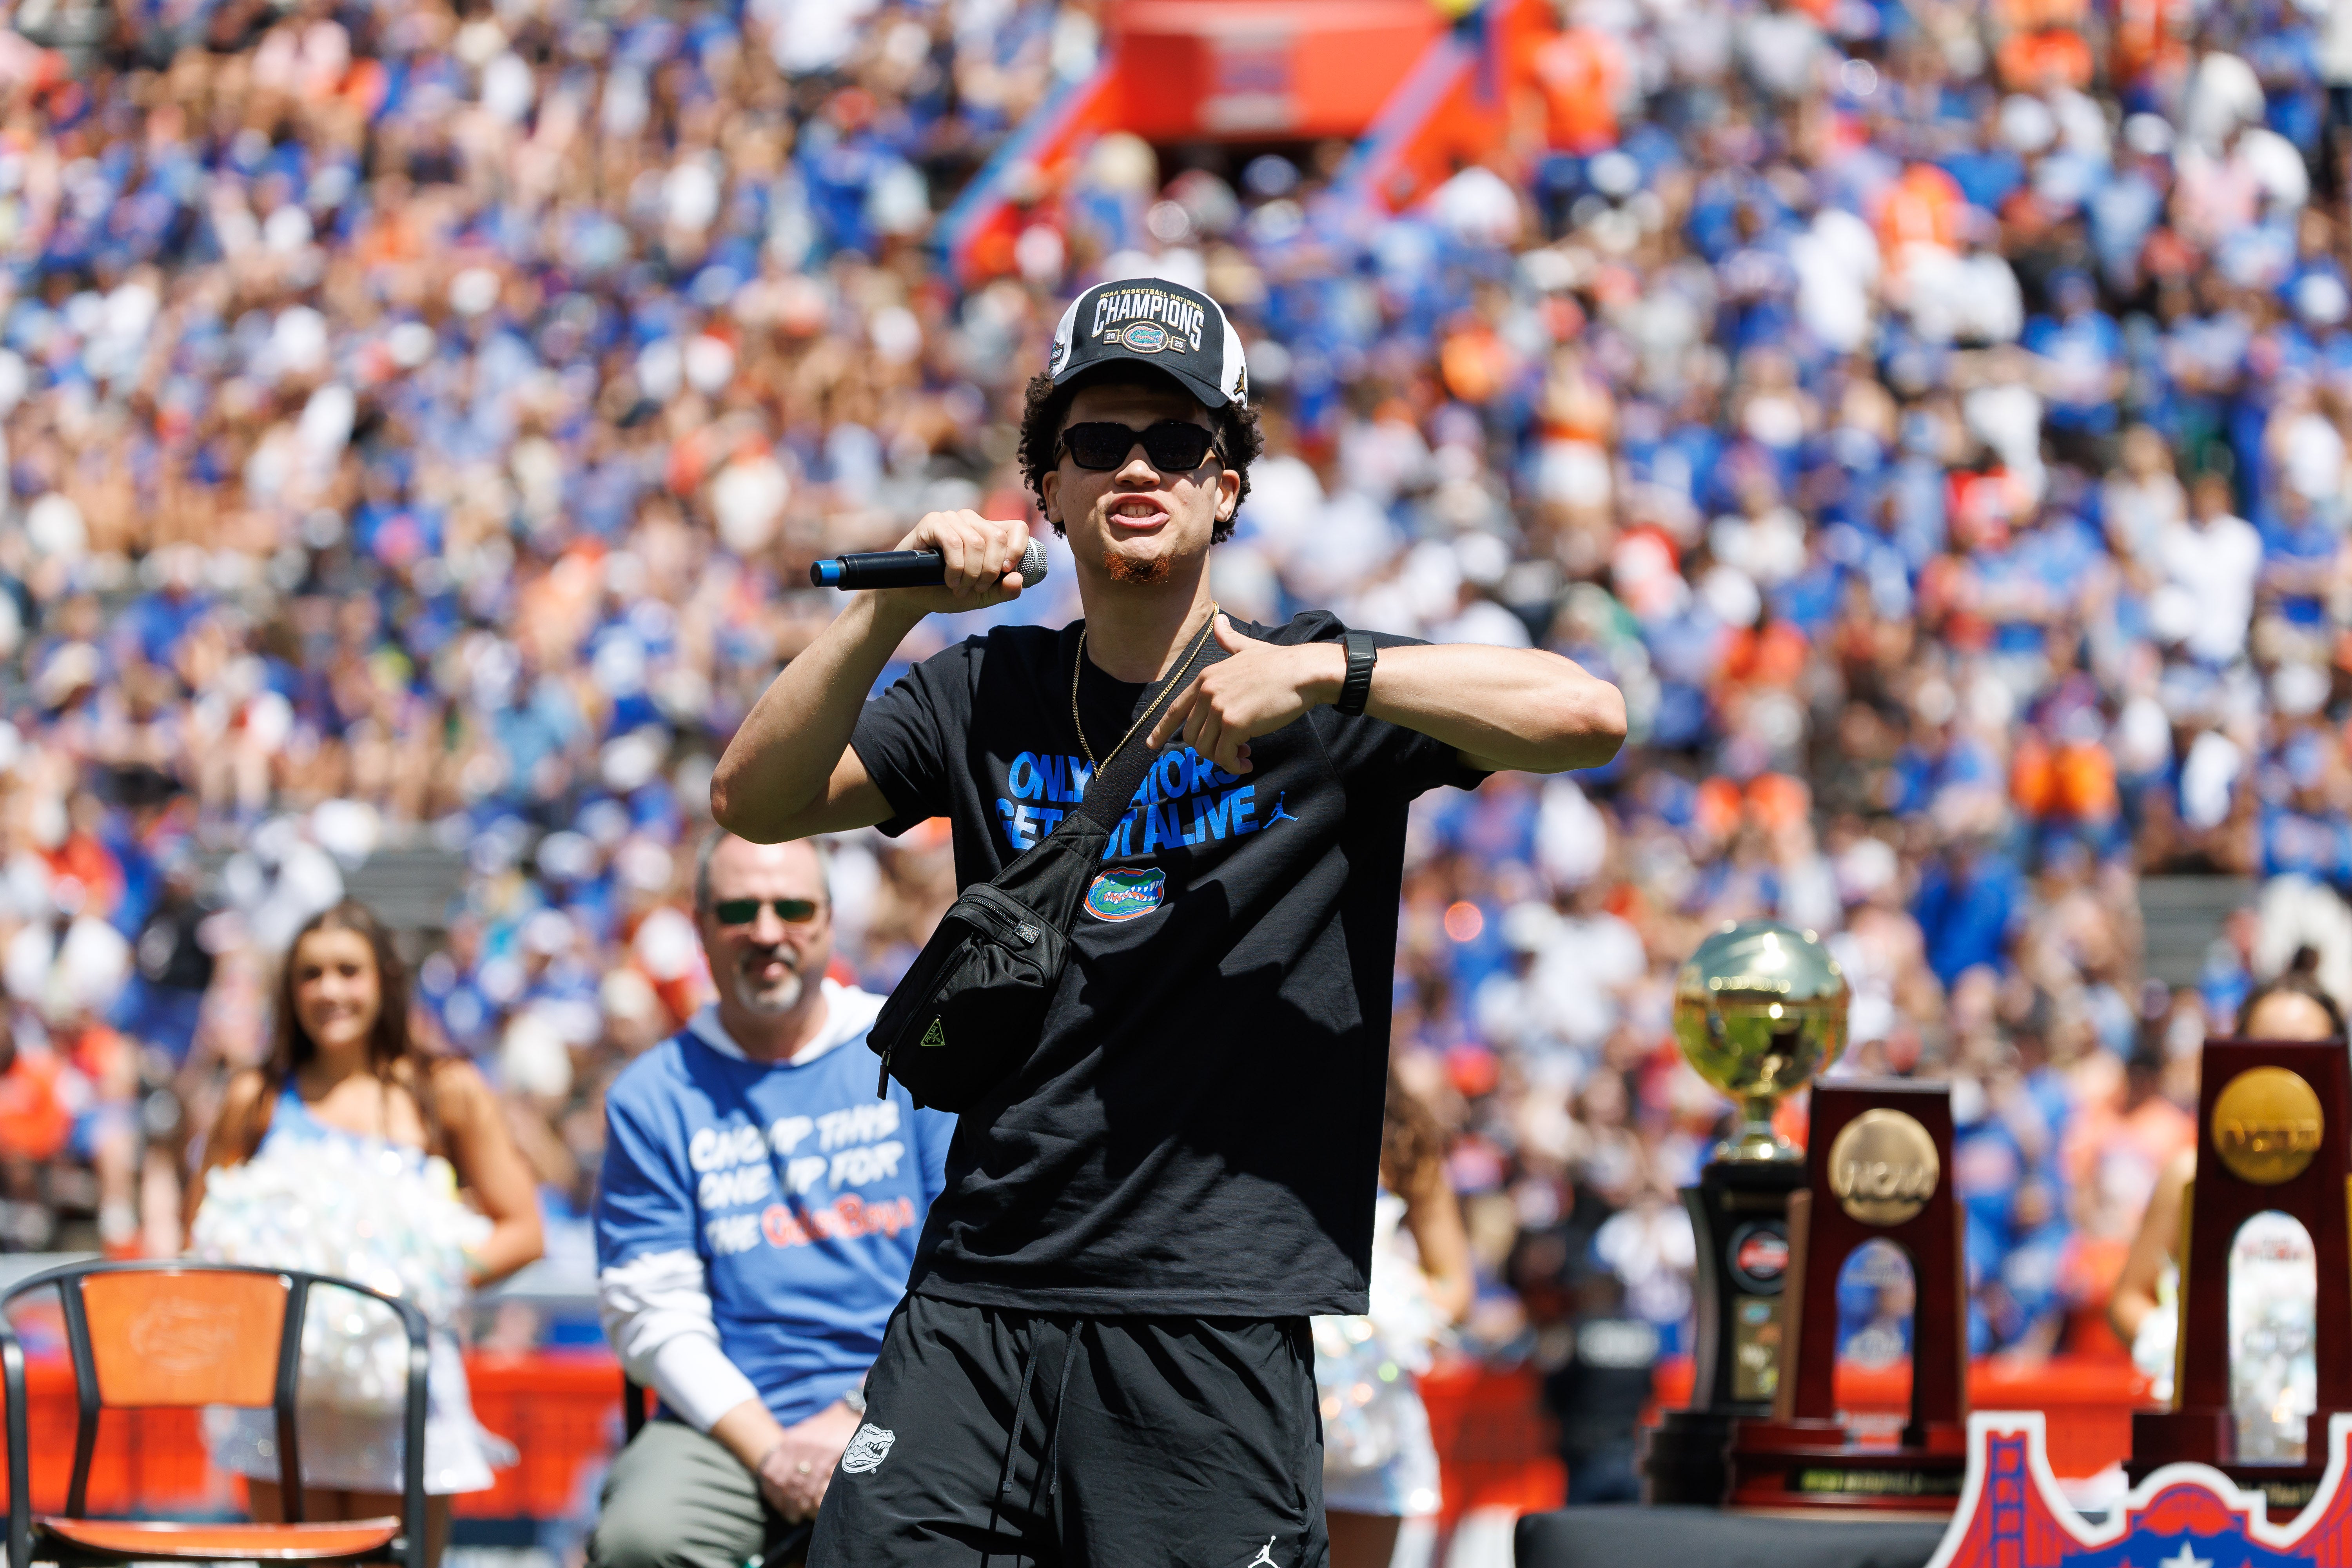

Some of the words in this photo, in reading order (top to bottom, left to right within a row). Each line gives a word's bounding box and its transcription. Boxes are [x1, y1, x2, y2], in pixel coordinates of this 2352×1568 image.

[1091, 294, 1205, 352] CHAMPIONS
[1100, 290, 1119, 299] NCAA
[1121, 288, 1168, 298] BASKETBALL
[1170, 293, 1204, 313] NATIONAL
[1174, 340, 1183, 348] 25
[1009, 751, 1098, 803] ONLY
[995, 798, 1063, 850] GET
[1143, 785, 1259, 853] ALIVE
[924, 1026, 938, 1043] PRADA
[828, 1140, 905, 1192] FOR
